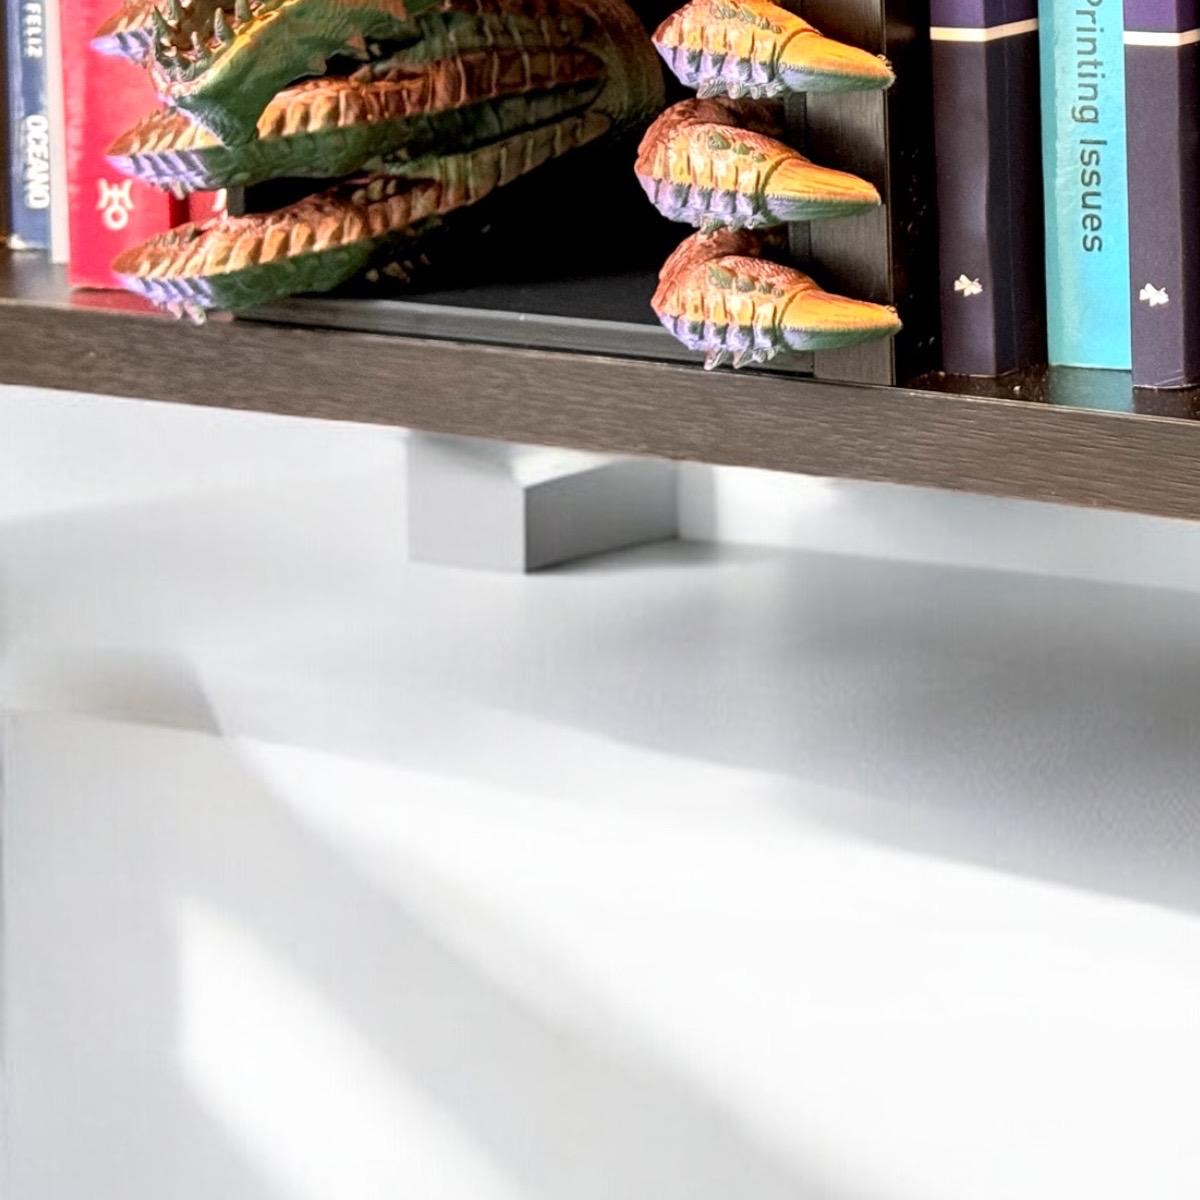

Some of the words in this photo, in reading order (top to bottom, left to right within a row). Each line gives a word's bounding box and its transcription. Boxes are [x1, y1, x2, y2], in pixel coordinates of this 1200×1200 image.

[24, 3, 43, 58] FELIZ
[25, 114, 50, 210] OCEANO
[1081, 139, 1108, 252] Issues
